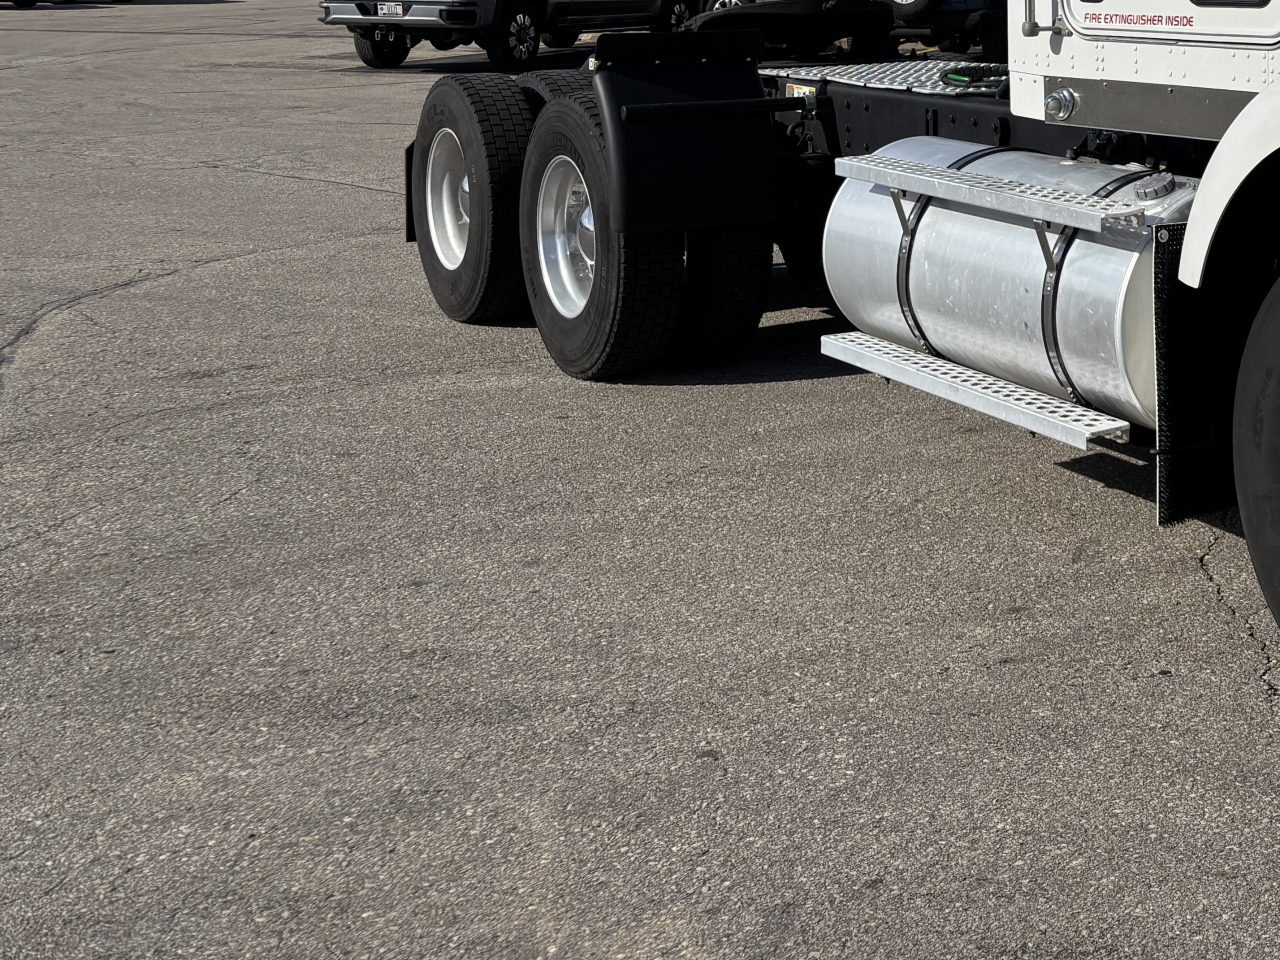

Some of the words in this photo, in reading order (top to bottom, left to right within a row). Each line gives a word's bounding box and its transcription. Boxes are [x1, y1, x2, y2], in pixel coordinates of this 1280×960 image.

[1084, 13, 1102, 24] FIRE
[1104, 14, 1164, 26] EXTINGUISHER
[1165, 16, 1194, 27] INSIDE
